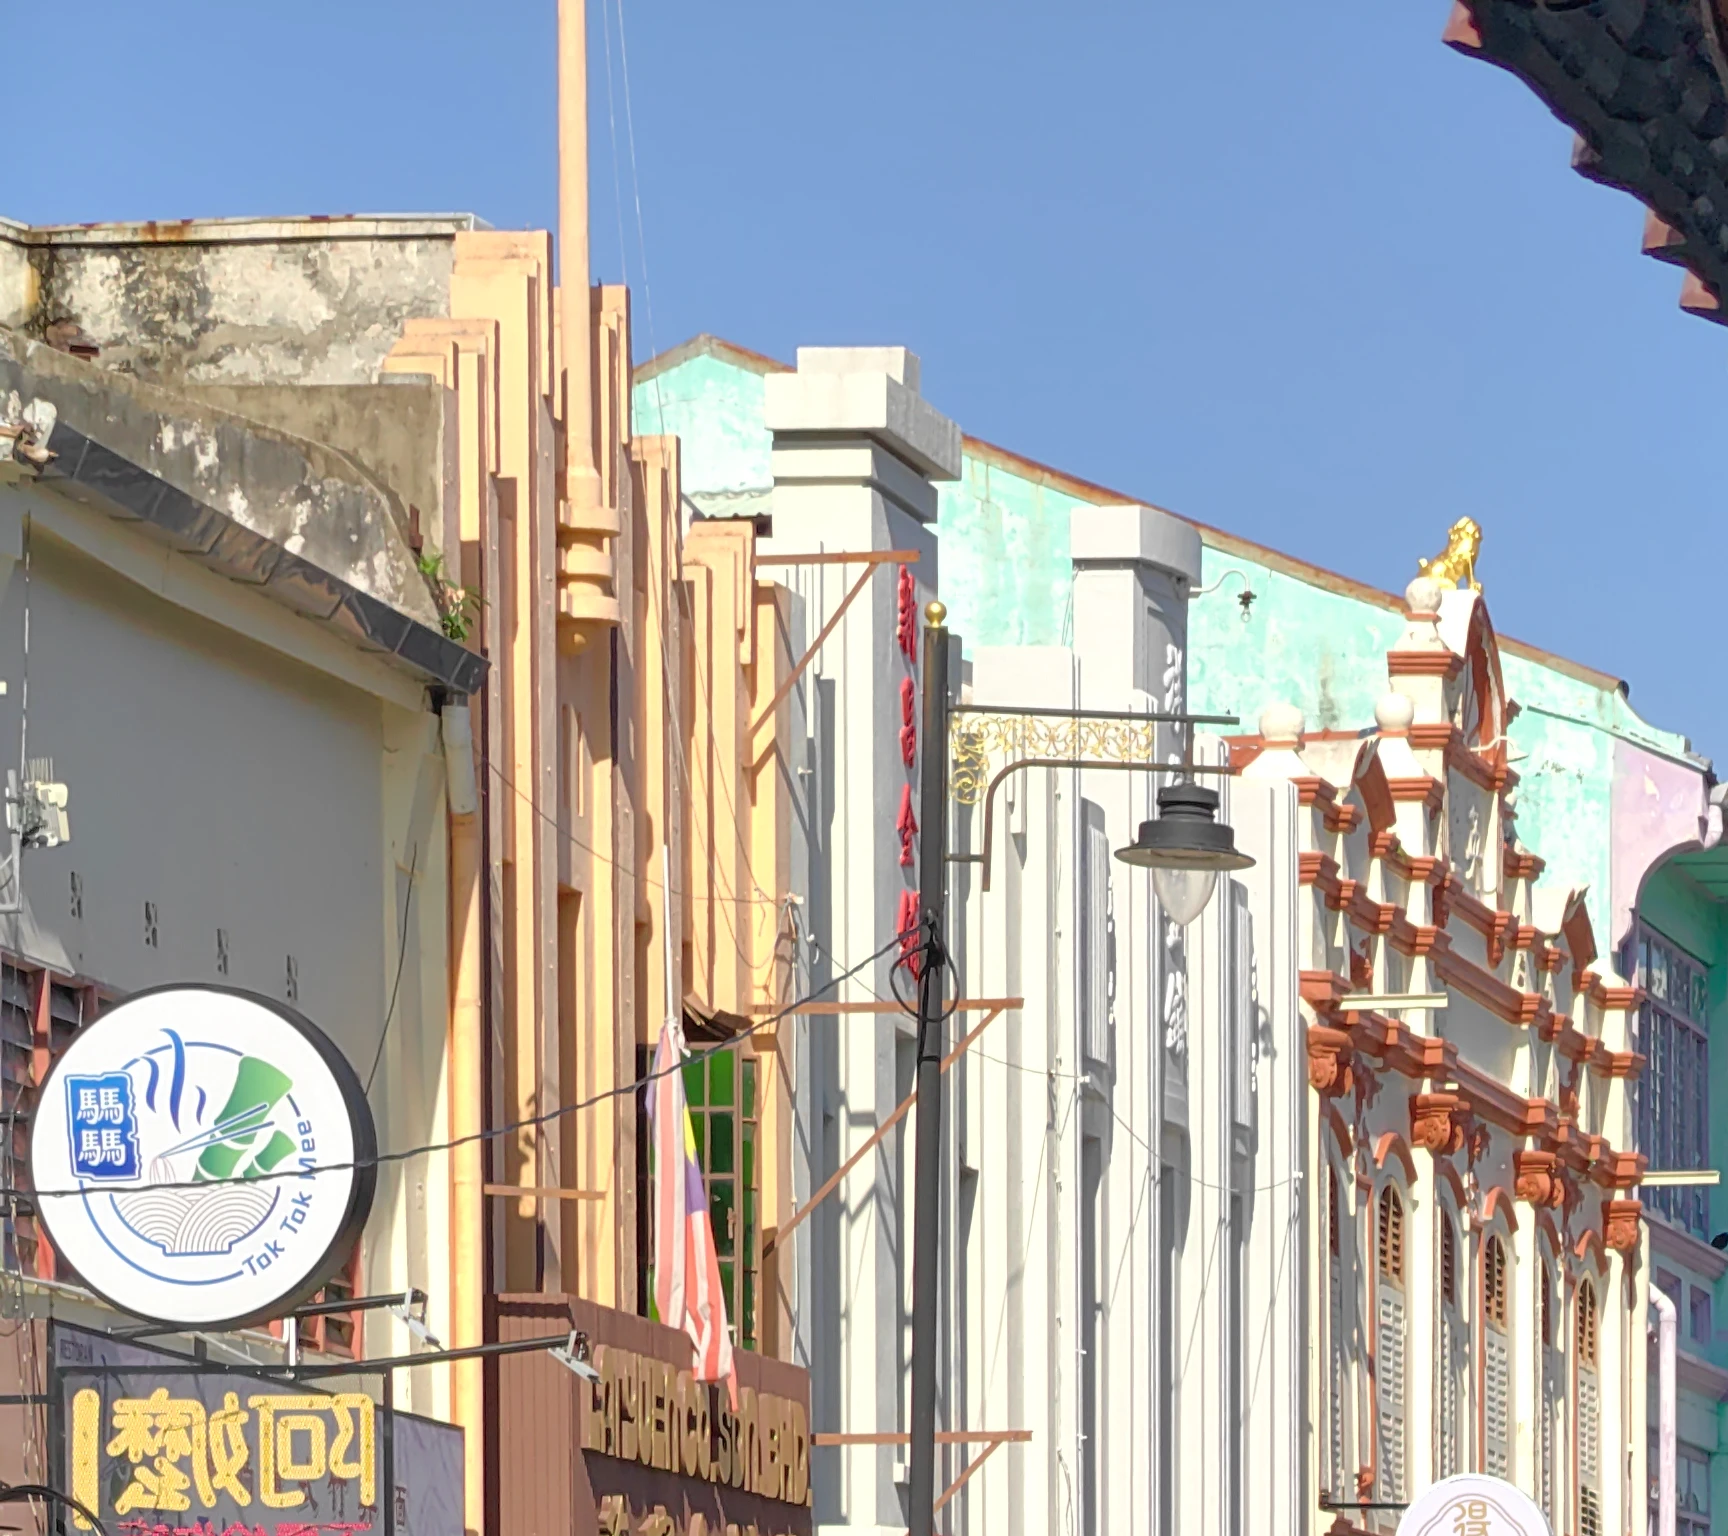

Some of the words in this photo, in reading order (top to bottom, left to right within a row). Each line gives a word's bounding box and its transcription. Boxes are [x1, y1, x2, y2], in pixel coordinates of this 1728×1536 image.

[242, 1239, 285, 1277] Tok
[280, 1190, 313, 1235] Tok
[298, 1119, 318, 1181] Mee
